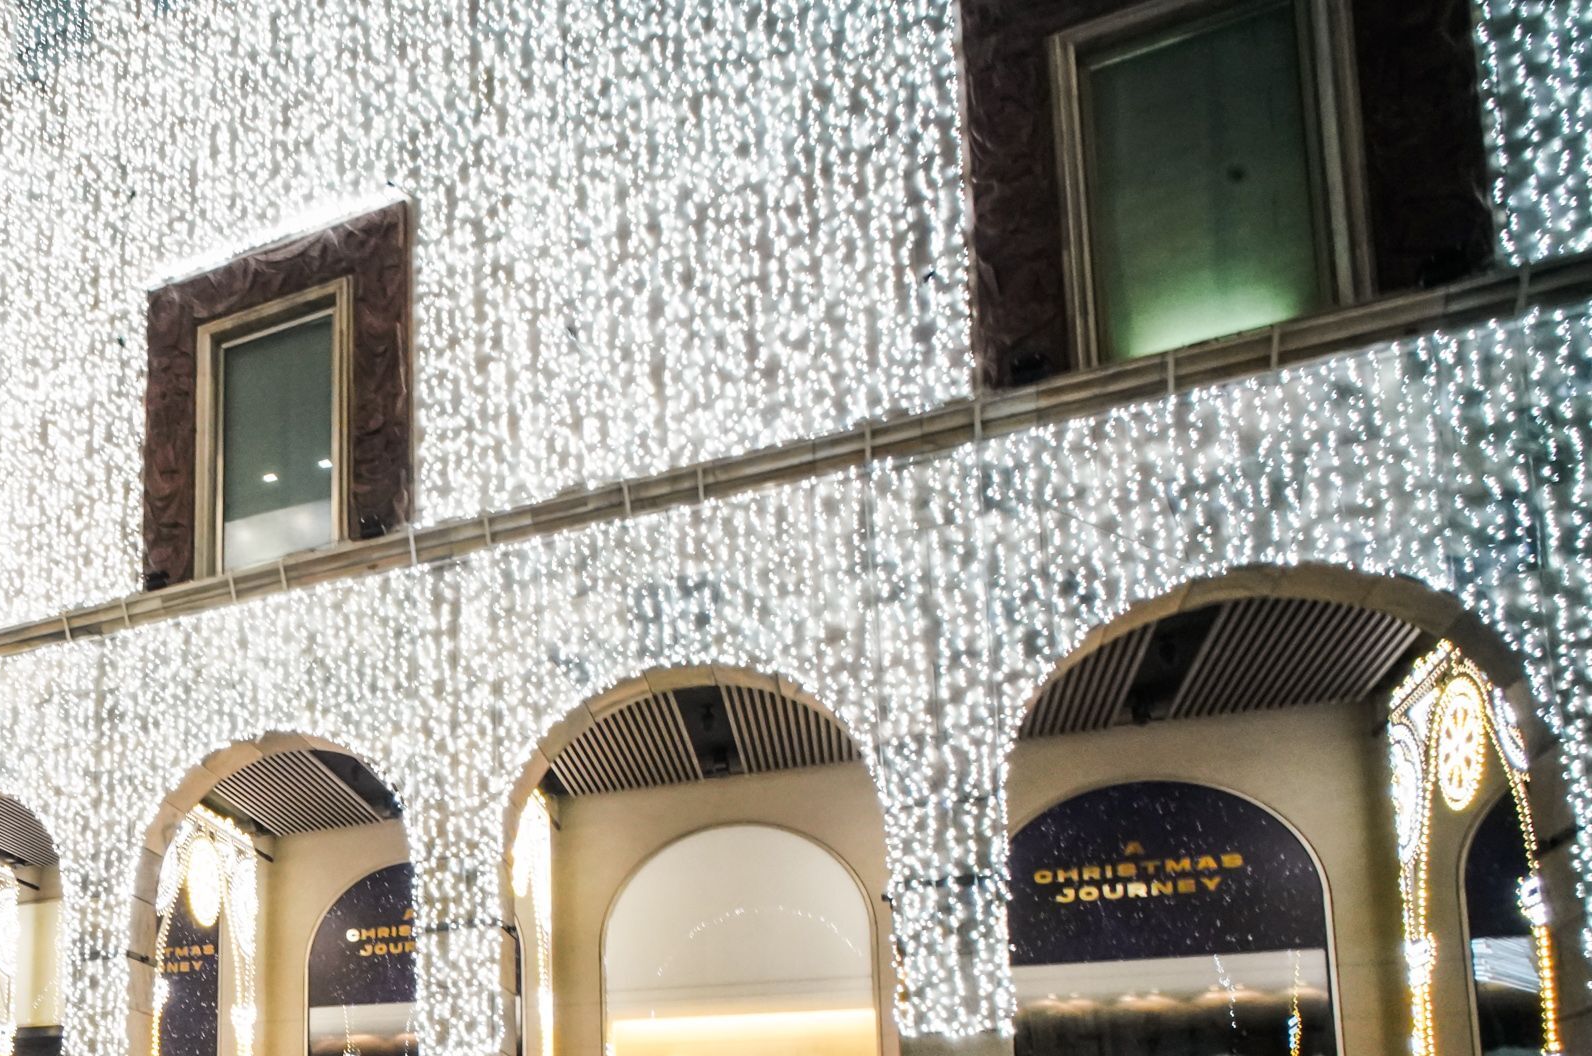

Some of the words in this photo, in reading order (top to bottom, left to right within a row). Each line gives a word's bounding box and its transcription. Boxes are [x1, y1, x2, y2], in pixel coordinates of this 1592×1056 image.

[1124, 841, 1144, 856] A
[1034, 852, 1243, 884] CHRISTMAS
[1056, 876, 1221, 903] JOURNEY
[346, 924, 412, 942] CHRIS
[360, 941, 416, 956] JOUR
